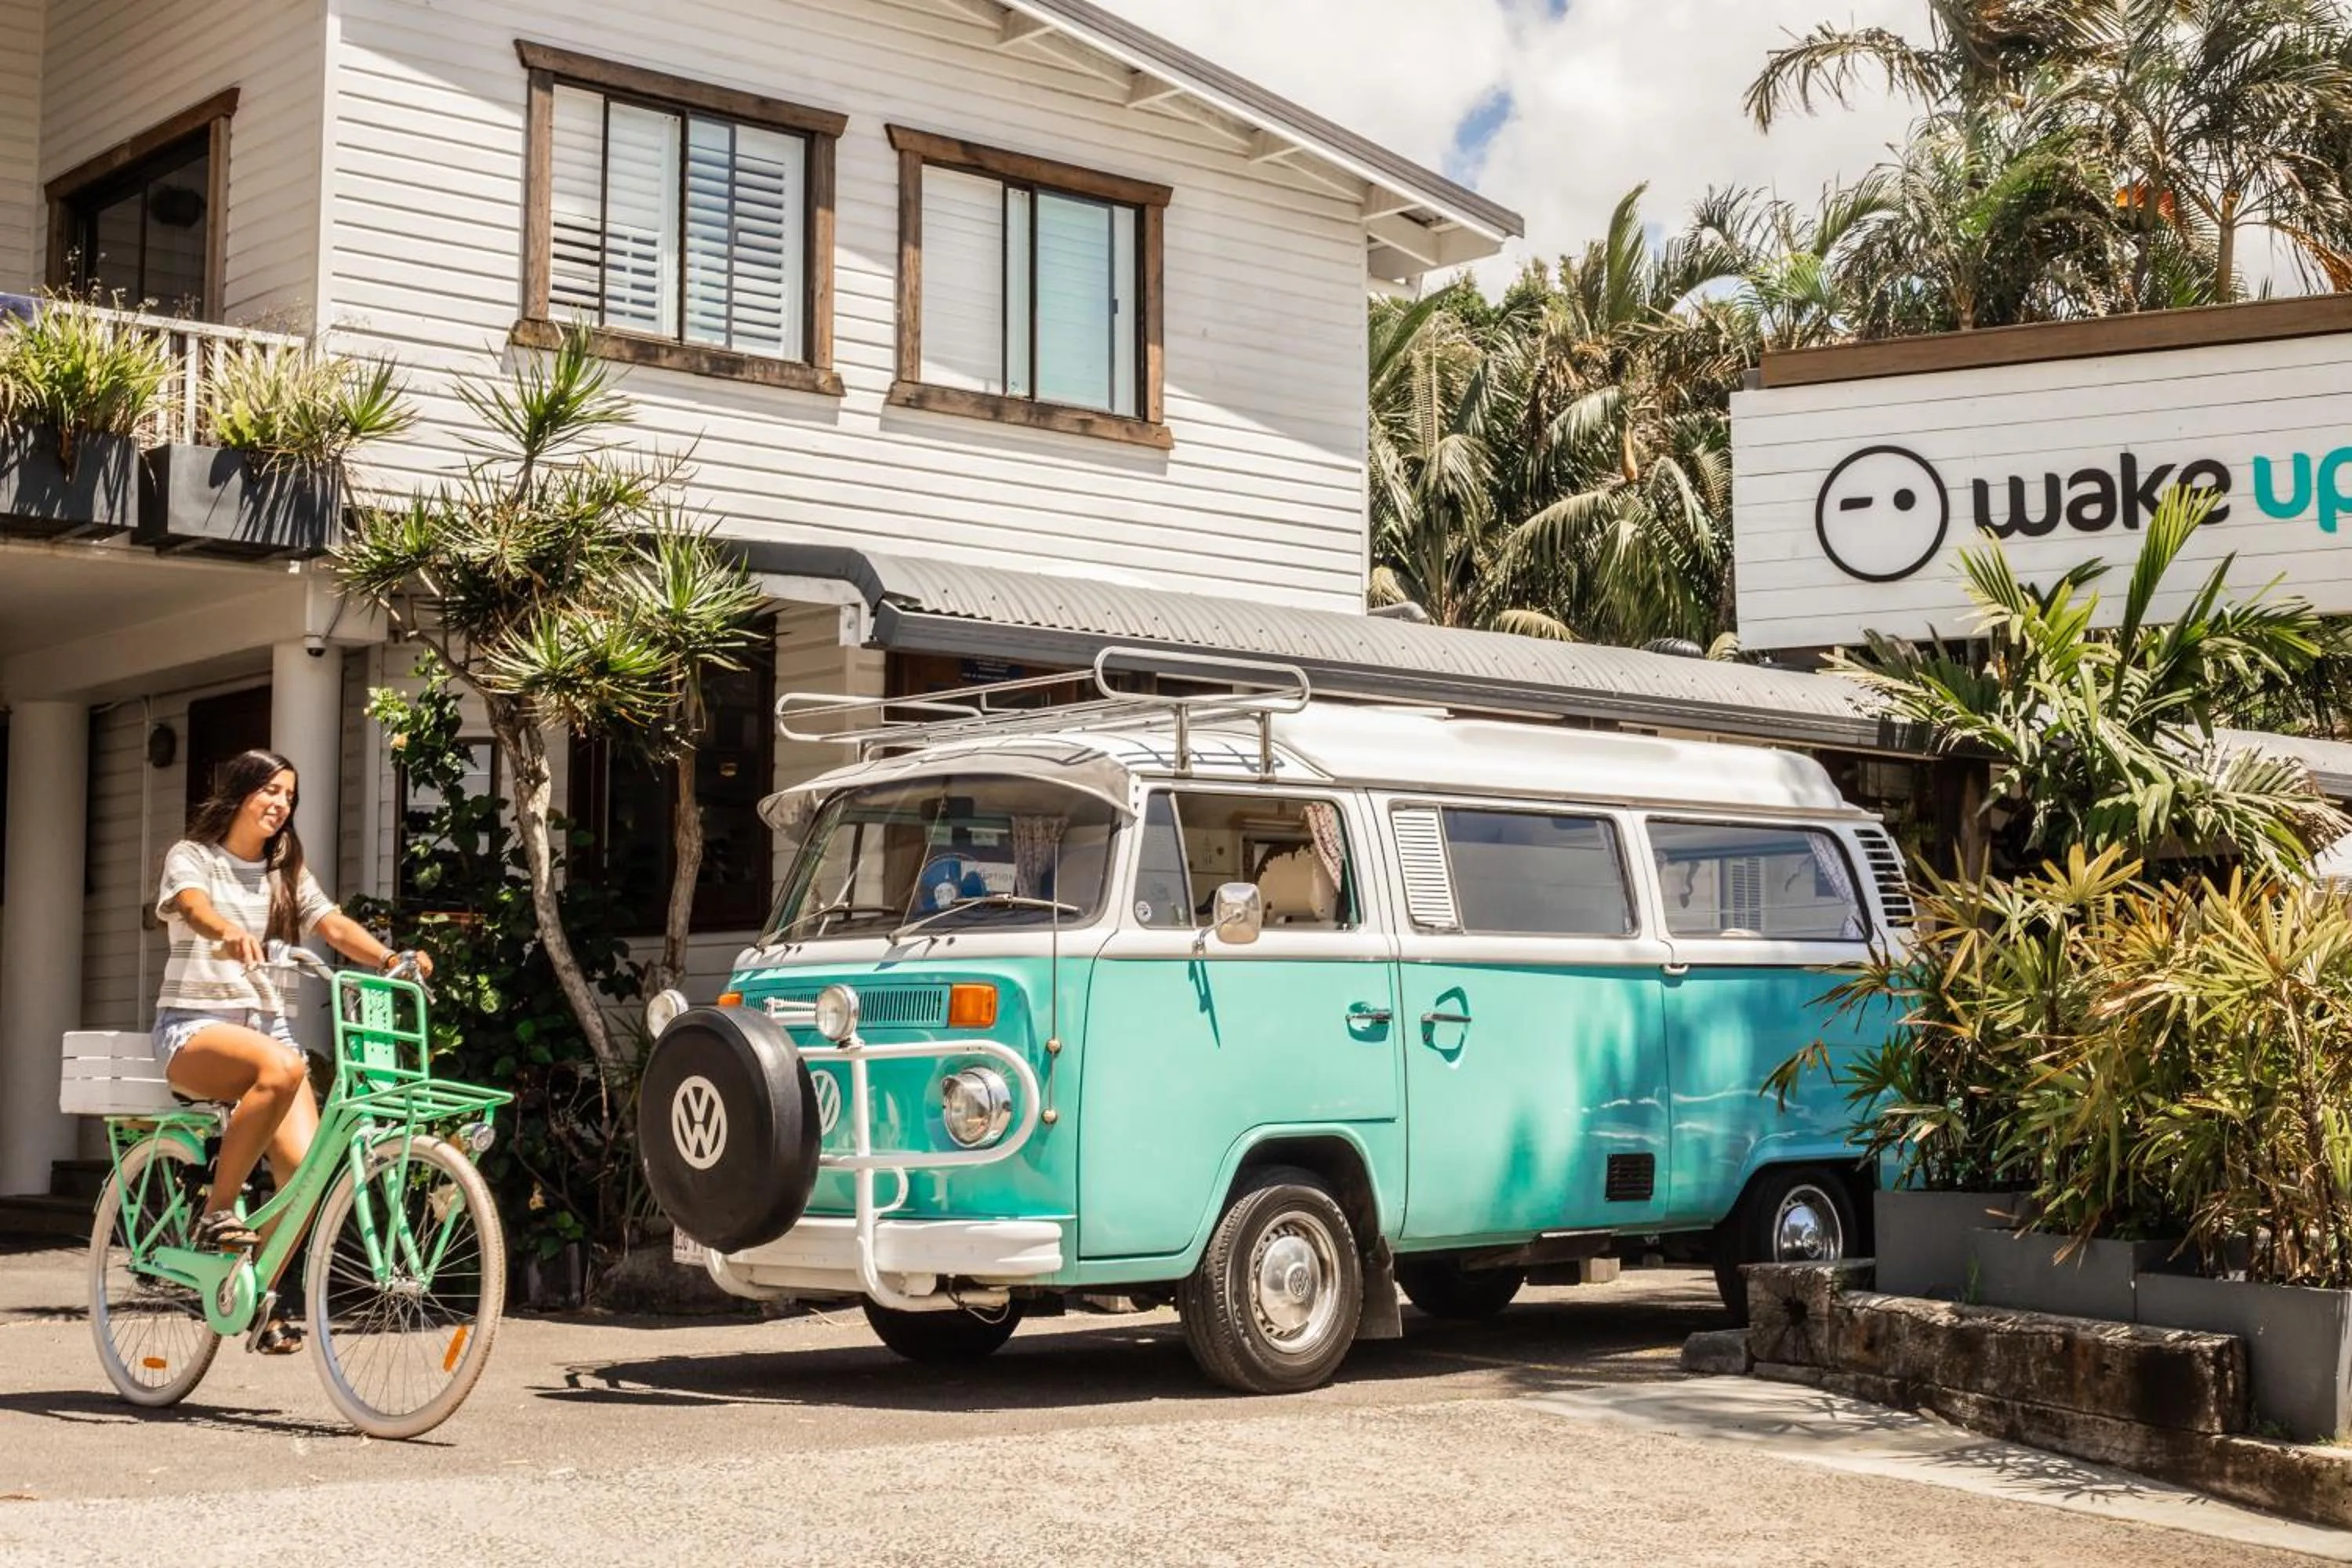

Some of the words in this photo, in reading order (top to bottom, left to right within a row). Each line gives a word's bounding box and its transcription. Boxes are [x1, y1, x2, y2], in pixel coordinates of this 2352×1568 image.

[1973, 452, 2231, 539] wake
[2253, 446, 2352, 533] up
[673, 1076, 725, 1168] VW
